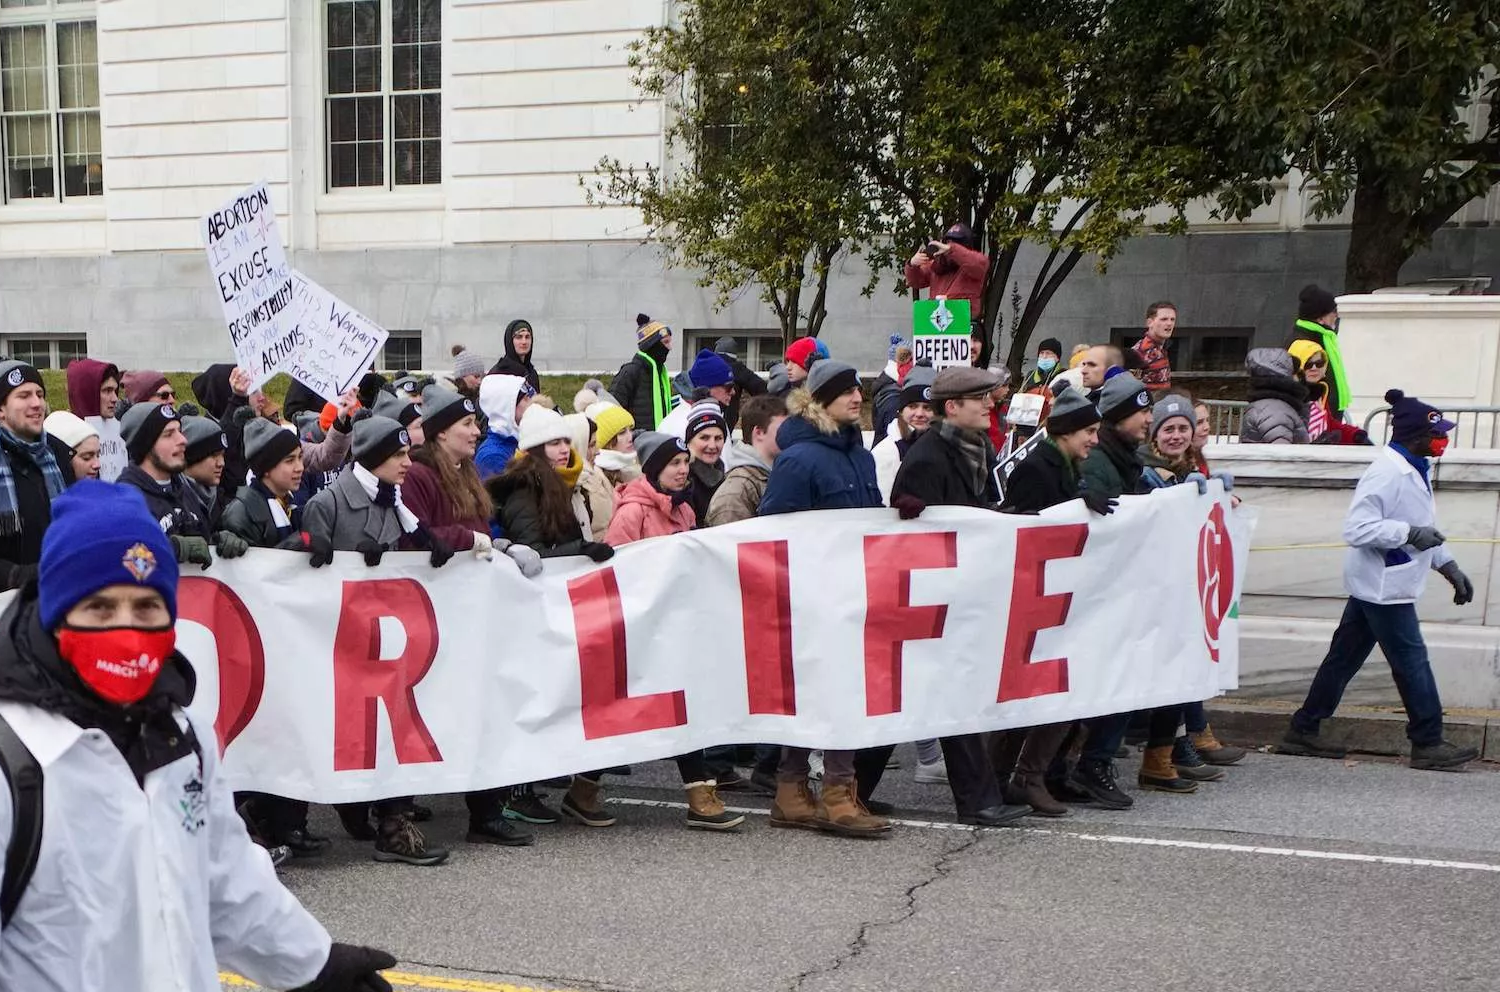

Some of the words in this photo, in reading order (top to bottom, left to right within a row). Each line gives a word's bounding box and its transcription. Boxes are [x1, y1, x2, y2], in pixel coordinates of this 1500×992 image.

[208, 187, 268, 244] ABORTION
[218, 246, 273, 302] EXCUSE
[916, 339, 968, 360] DEFEND
[566, 523, 1089, 740] LIFE
[96, 658, 138, 678] MARCH
